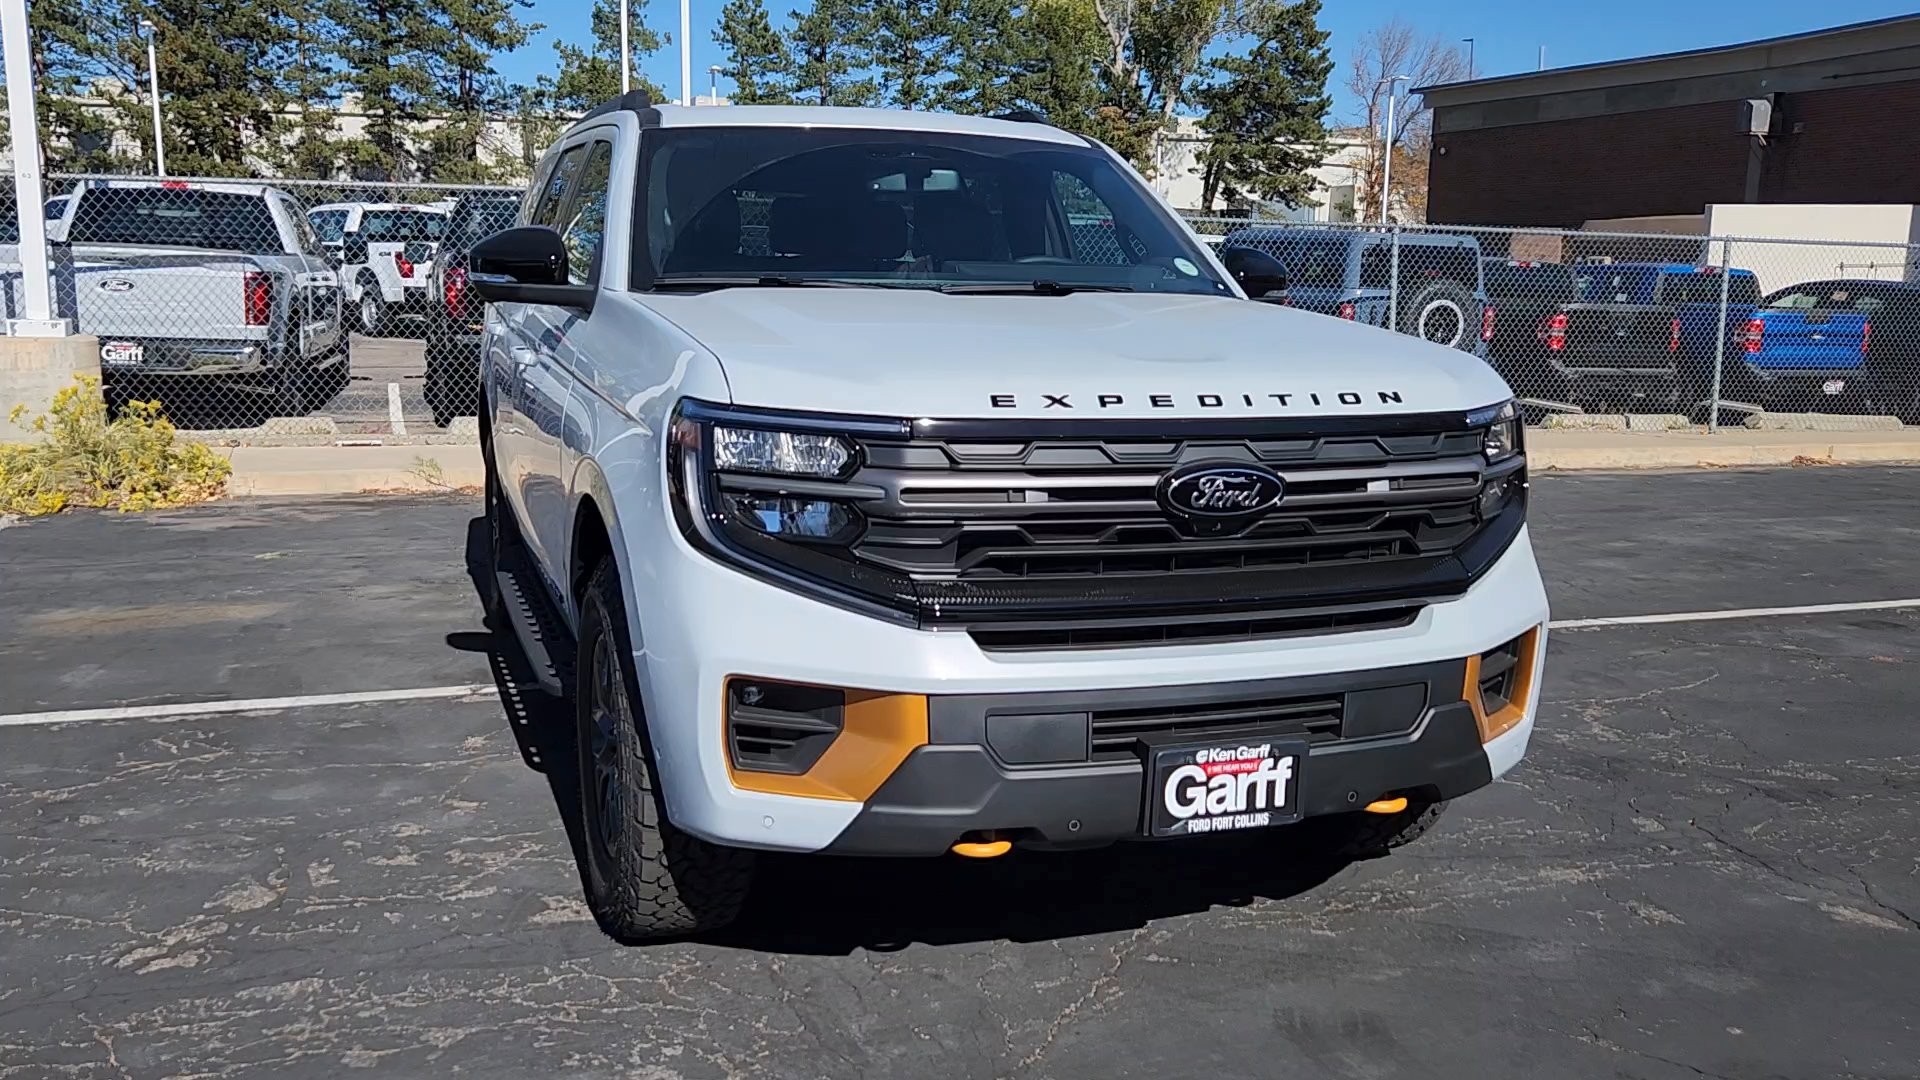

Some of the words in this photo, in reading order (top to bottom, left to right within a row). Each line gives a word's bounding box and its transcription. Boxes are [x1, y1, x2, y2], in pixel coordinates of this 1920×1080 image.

[101, 345, 144, 361] Garff
[990, 391, 1403, 408] EXPEDITION
[1191, 475, 1261, 508] Ford
[1208, 748, 1236, 763] Ken
[1236, 744, 1271, 760] Garff
[1223, 762, 1240, 771] HEAR
[1240, 760, 1254, 769] YOU
[1164, 757, 1293, 819] Garff
[1187, 819, 1211, 834] FORD
[1211, 816, 1234, 831] FORT
[1234, 812, 1270, 828] COLLINS
